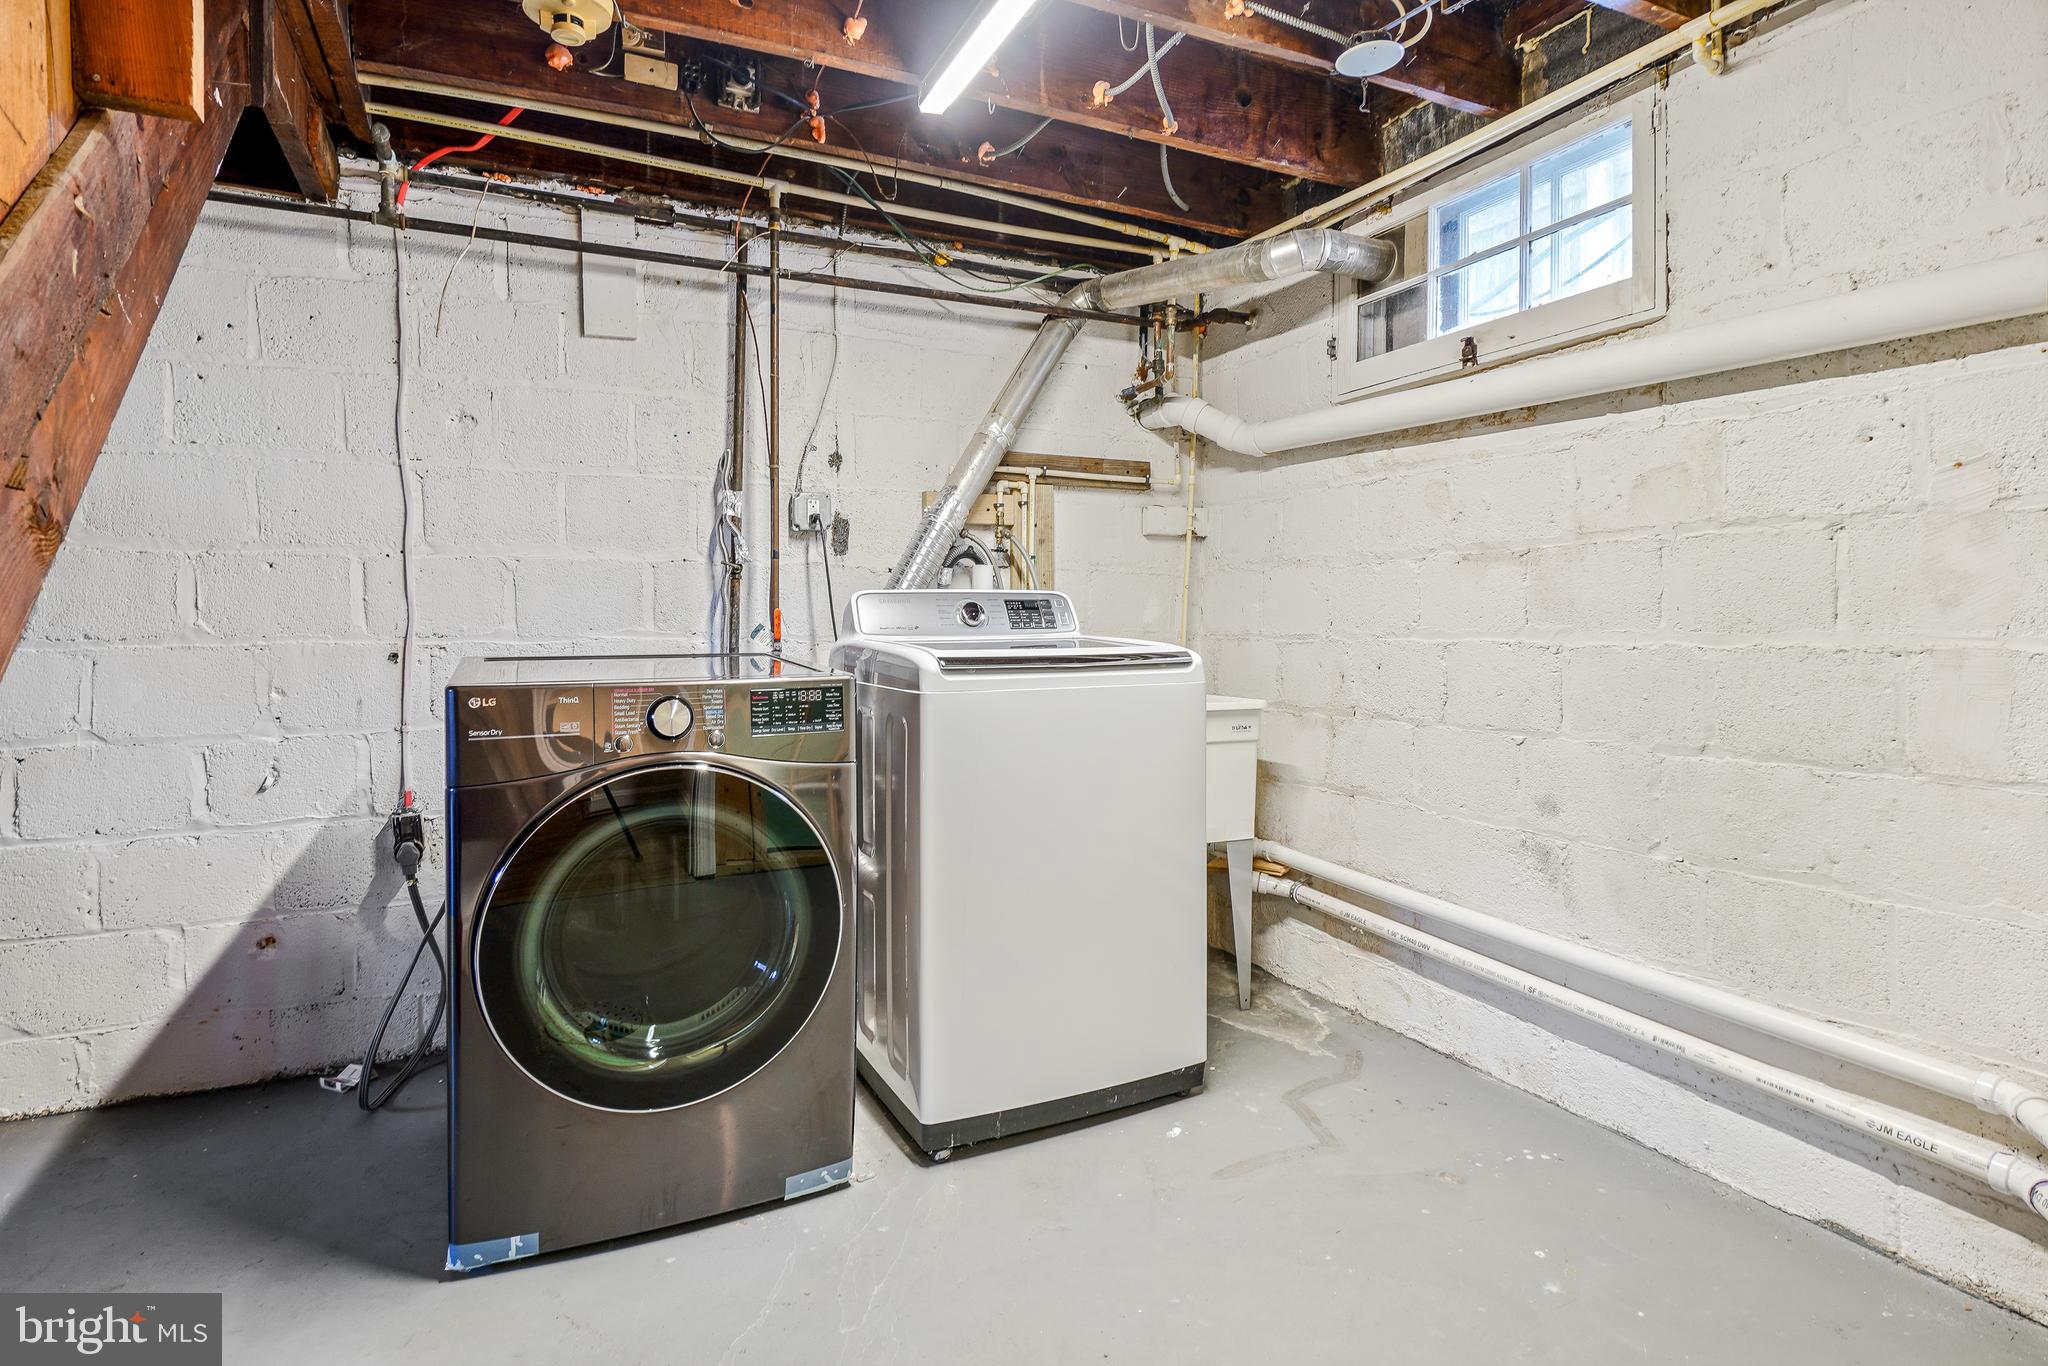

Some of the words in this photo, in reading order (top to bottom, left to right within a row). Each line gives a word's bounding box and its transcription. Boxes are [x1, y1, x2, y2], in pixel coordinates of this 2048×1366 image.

[482, 697, 497, 707] LG
[558, 696, 579, 704] ThinQ
[468, 729, 503, 737] SensorDry
[1876, 1124, 1893, 1136] JM
[1896, 1130, 1940, 1154] EAGLE
